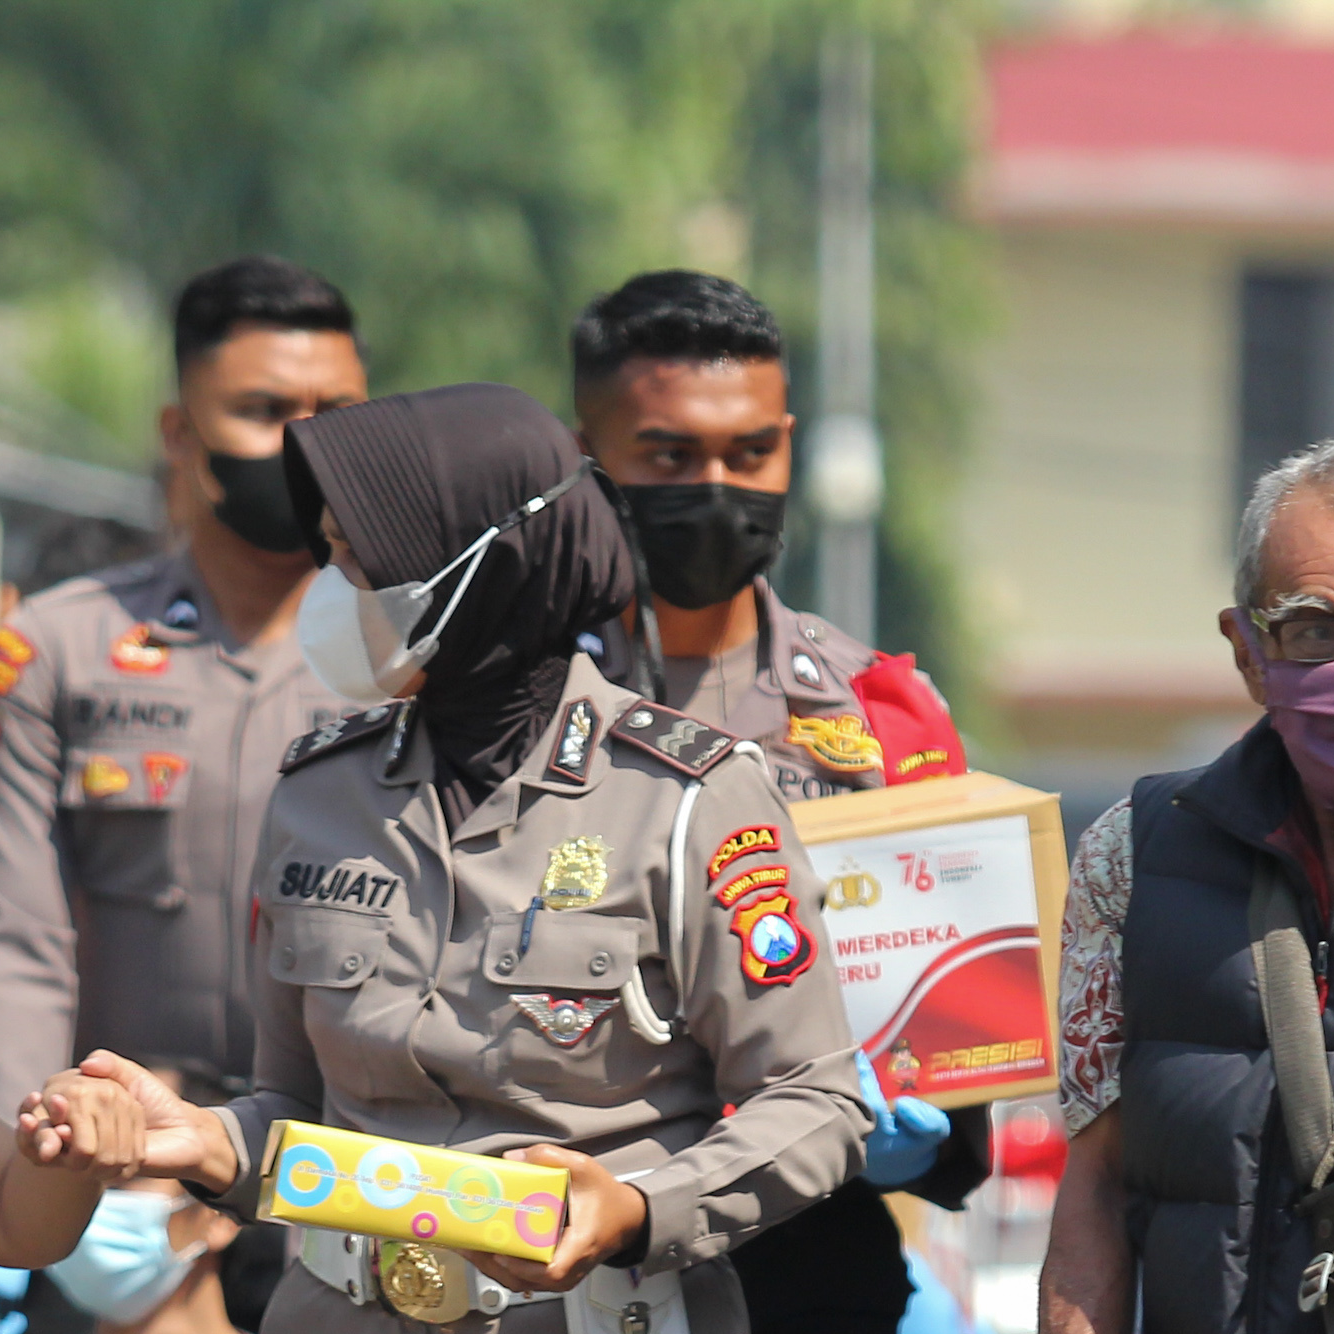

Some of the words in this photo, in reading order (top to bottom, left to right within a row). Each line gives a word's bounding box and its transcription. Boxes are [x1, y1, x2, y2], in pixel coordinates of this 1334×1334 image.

[710, 828, 774, 874] POLDA
[279, 860, 399, 908] SUJIATI
[722, 874, 754, 902] JAWA
[752, 867, 787, 886] TIMUR
[835, 923, 963, 957] MERDEKA
[929, 1038, 1044, 1072] PRESISI
